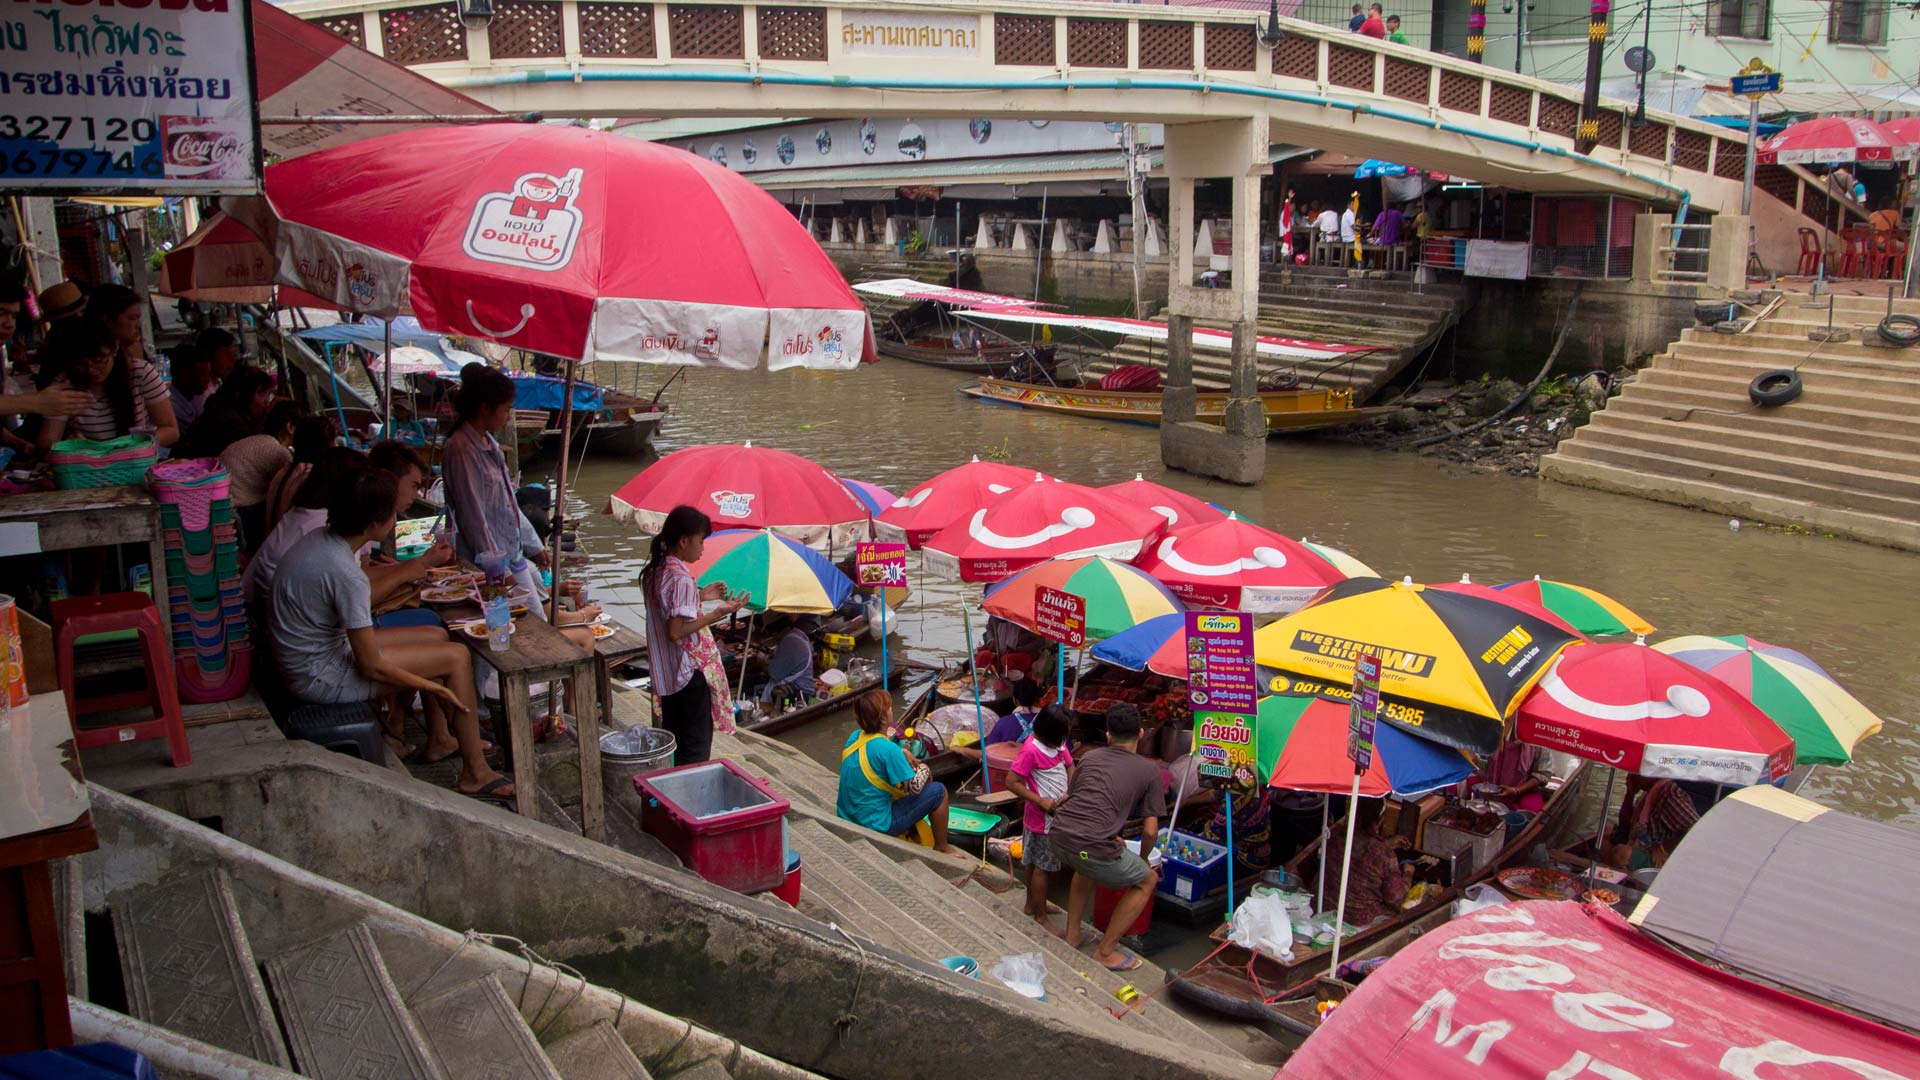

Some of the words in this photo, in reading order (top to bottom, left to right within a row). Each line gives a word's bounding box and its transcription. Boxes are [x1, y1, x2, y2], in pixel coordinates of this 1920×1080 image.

[33, 9, 187, 57] ไหว้พระ
[1070, 631, 1082, 644] 30
[1300, 631, 1375, 655] WESTERN
[1303, 655, 1335, 668] moving
[1318, 644, 1357, 662] UNIO
[1381, 649, 1428, 674] WU
[1294, 681, 1321, 694] 001
[1385, 701, 1425, 726] 5385
[1566, 728, 1580, 740] 3G
